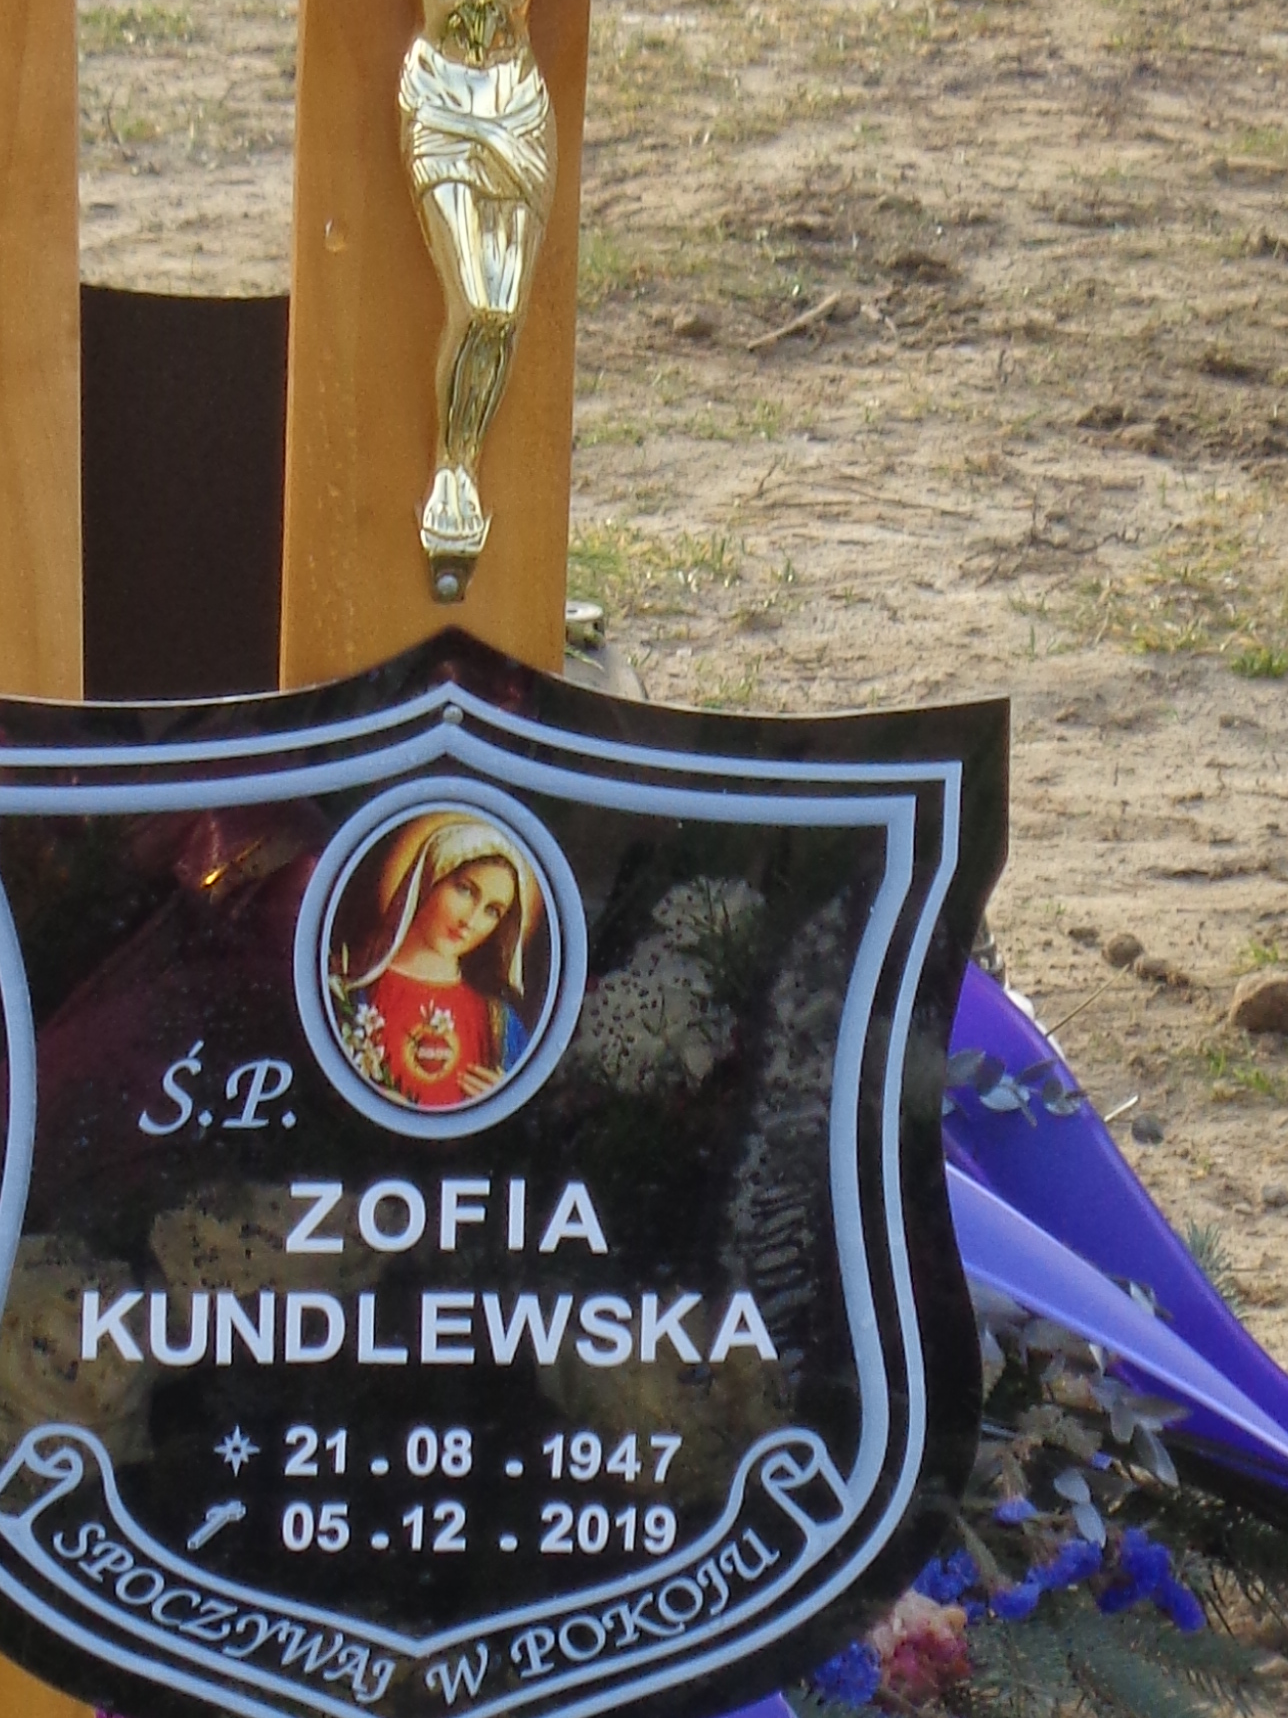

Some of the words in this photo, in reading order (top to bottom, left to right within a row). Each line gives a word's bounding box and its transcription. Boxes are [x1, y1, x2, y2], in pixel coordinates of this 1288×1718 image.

[137, 1039, 298, 1136] Ś.P.
[284, 1178, 610, 1255] ZOFIA
[79, 1289, 779, 1368] KUNDLEWSKA
[51, 1519, 397, 1704] SPOCZYWAJ
[424, 1641, 493, 1708] W
[511, 1527, 781, 1681] POKOJU
